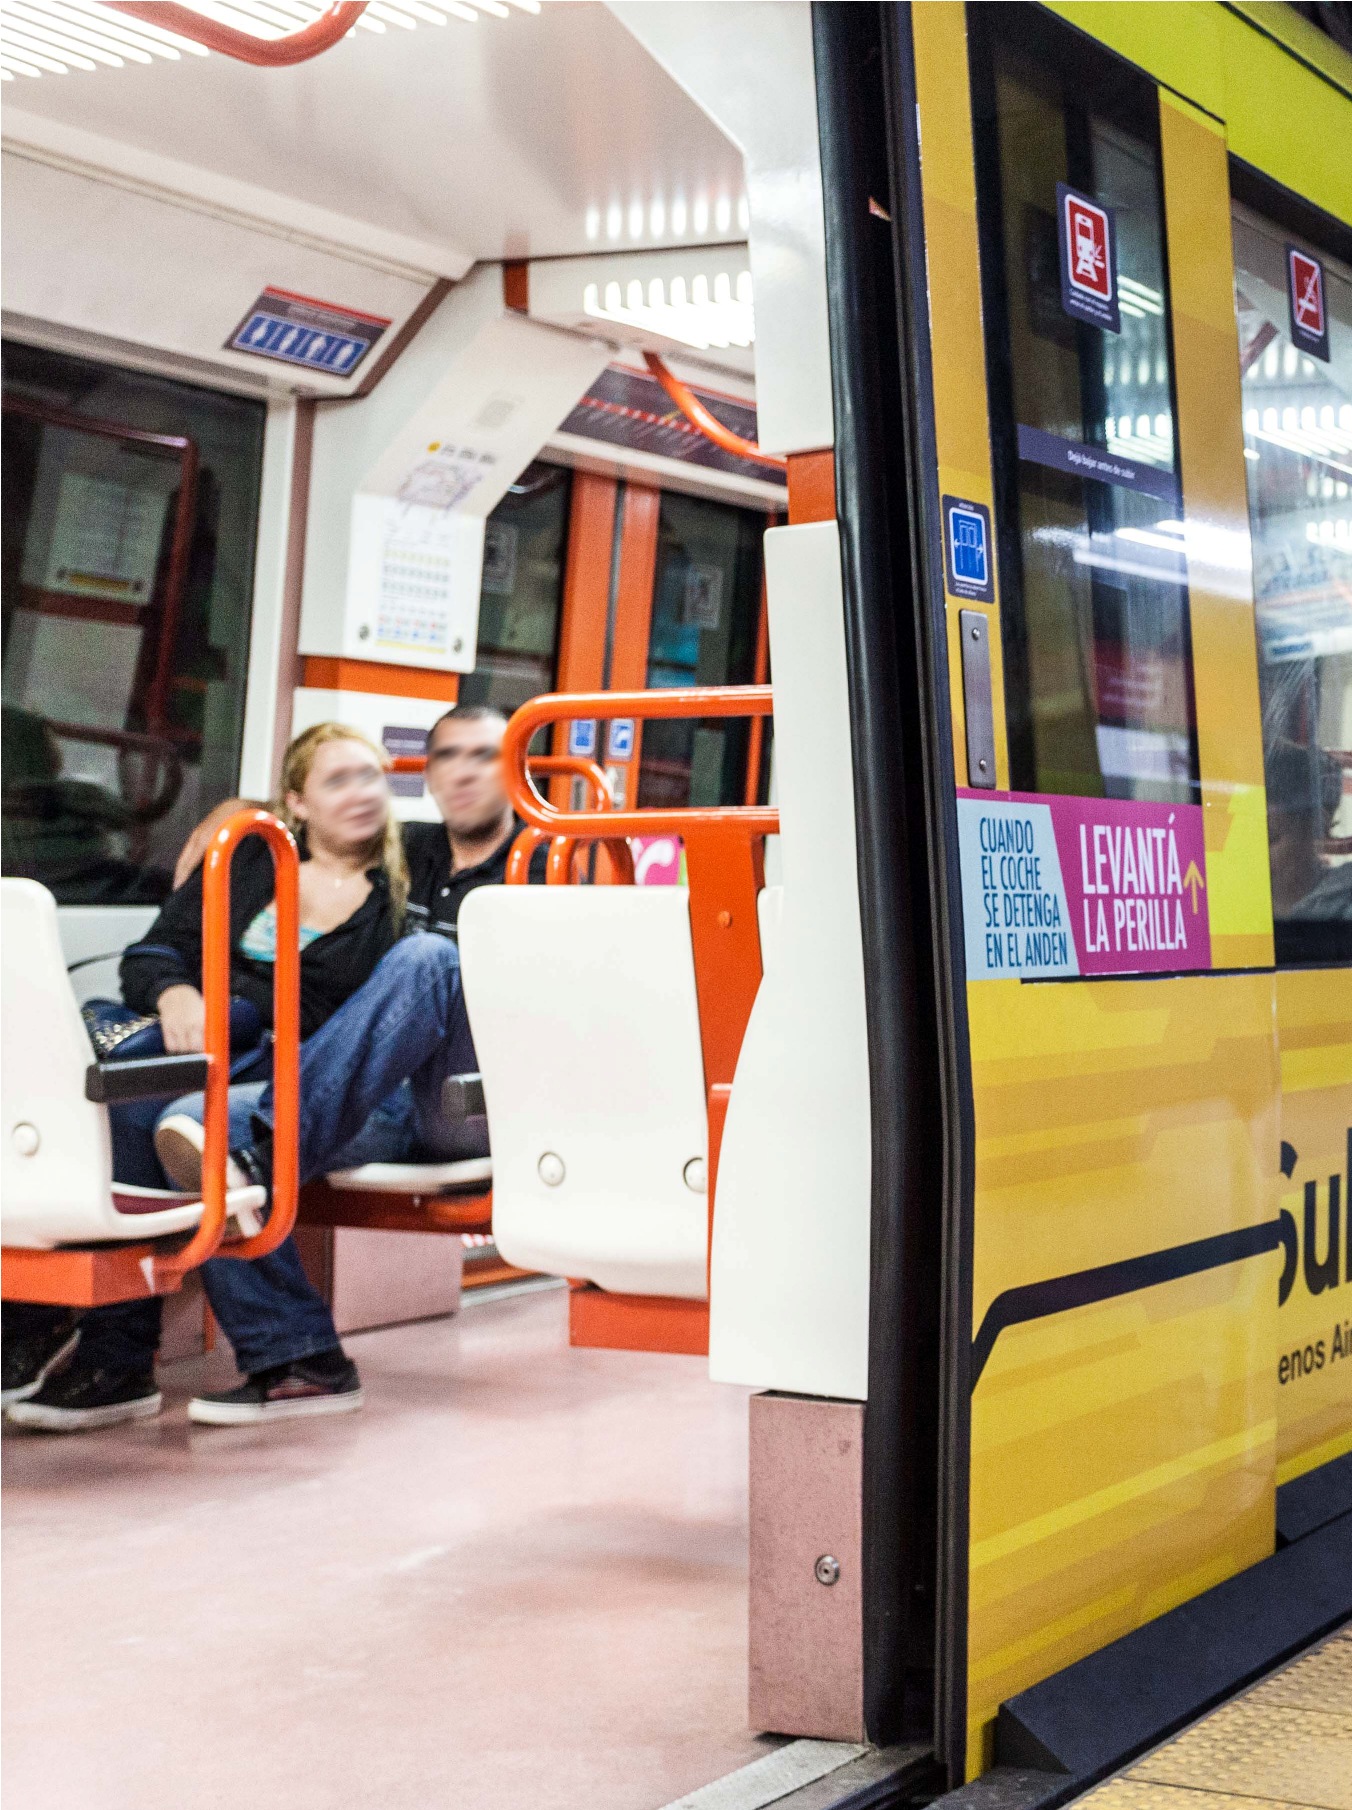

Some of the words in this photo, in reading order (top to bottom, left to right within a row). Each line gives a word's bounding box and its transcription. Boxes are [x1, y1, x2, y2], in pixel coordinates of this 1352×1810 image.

[979, 816, 1034, 853] CUANDO
[1079, 812, 1184, 895] LEVANTÁ
[981, 857, 997, 891] EL
[1000, 856, 1042, 891] COCHE
[983, 893, 1000, 928] SE
[1003, 893, 1061, 929] DETENGA
[1083, 898, 1111, 953] LA
[1113, 898, 1188, 952] PERILLA
[986, 932, 1003, 968] EN
[1007, 932, 1022, 968] EL
